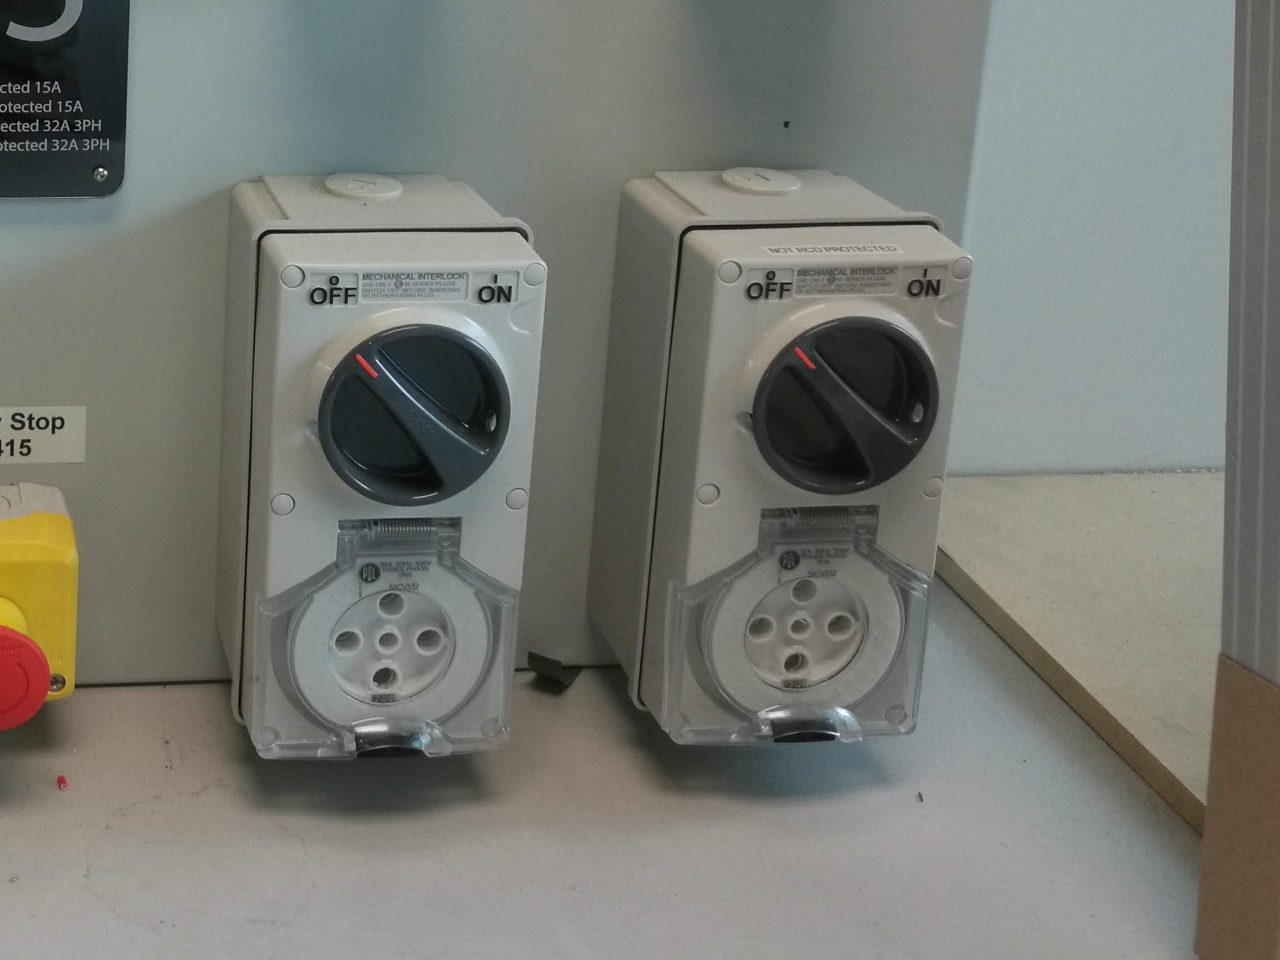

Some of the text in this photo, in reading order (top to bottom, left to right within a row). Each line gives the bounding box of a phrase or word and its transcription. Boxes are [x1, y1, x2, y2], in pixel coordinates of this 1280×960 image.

[35, 81, 61, 93] 15A
[56, 100, 83, 112] 15A
[43, 119, 70, 132] 32A
[73, 119, 102, 132] 3PH
[51, 139, 79, 151] 32A
[82, 139, 110, 151] 3PH
[797, 246, 822, 254] RCD
[824, 245, 897, 253] PROTECTED
[361, 272, 465, 281] MECHANICAL INTERLOCK
[850, 267, 896, 276] INTERLOCK
[477, 285, 513, 303] ON
[746, 282, 792, 300] OFF
[906, 279, 941, 297] ON
[309, 287, 357, 305] OFF
[10, 412, 65, 435] Stop
